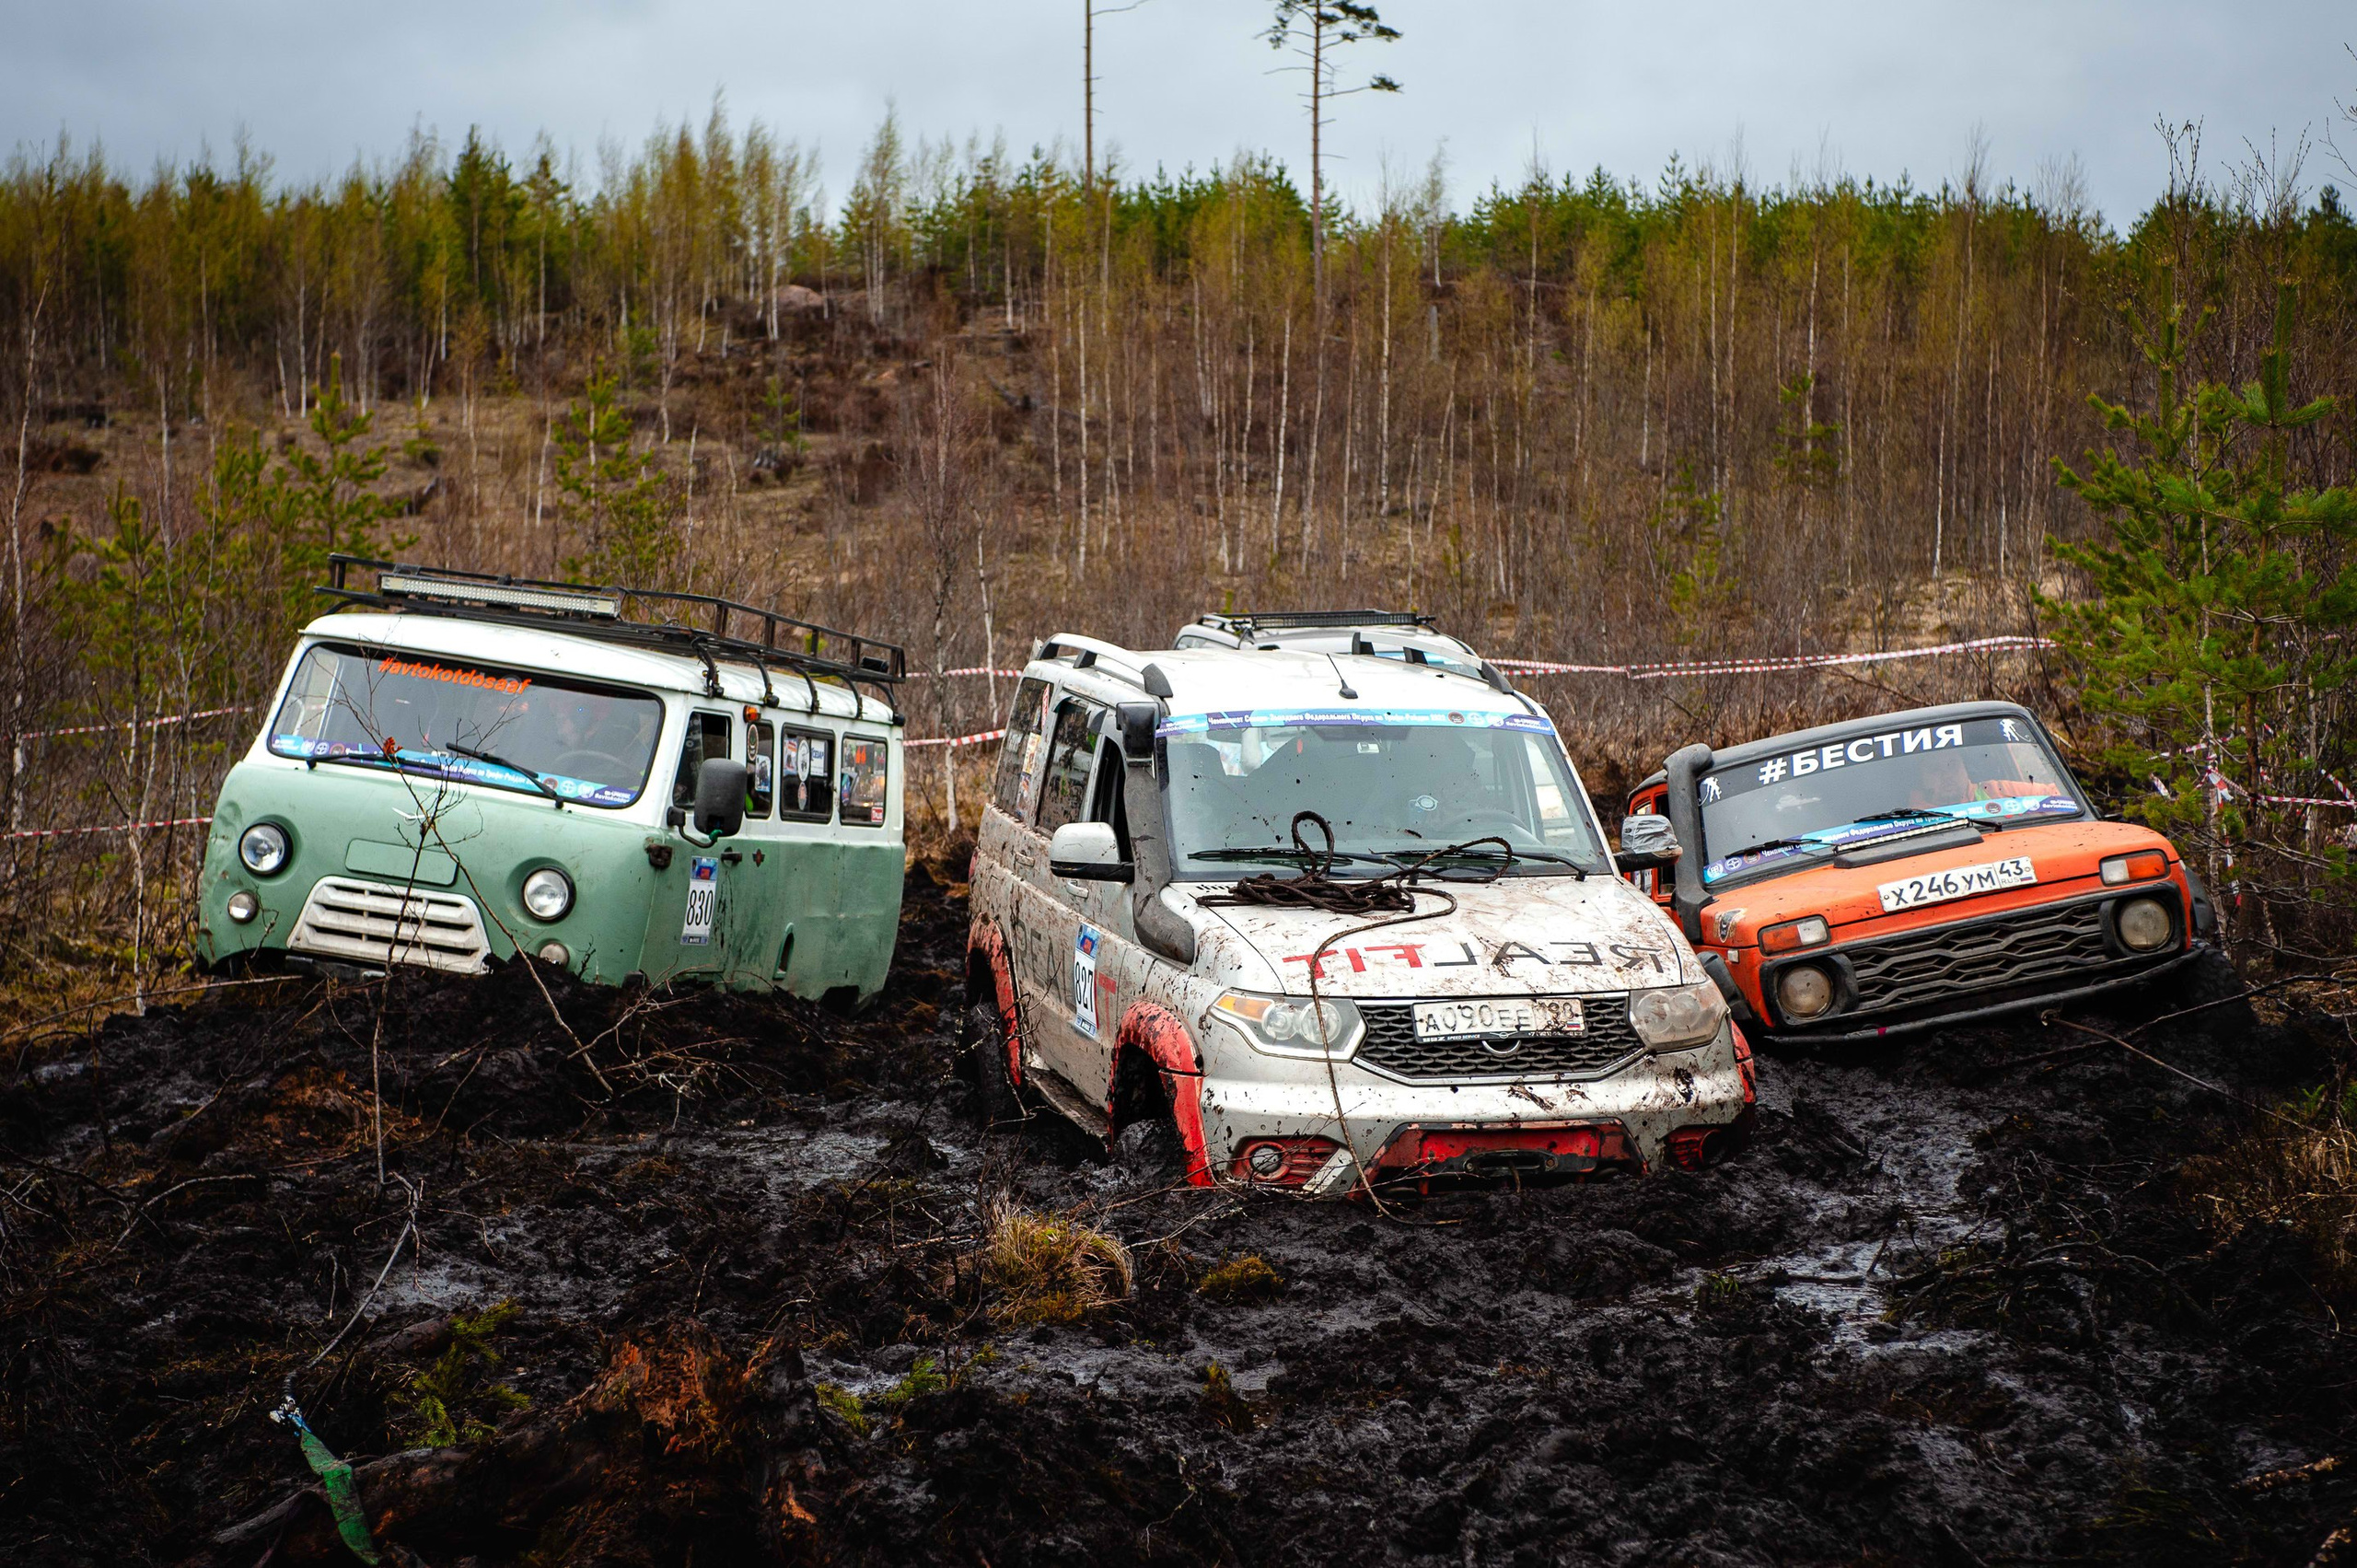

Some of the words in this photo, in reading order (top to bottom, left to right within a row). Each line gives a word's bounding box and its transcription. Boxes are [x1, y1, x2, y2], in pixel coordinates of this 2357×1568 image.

[378, 657, 531, 694] #avtokotdosaaf
[1759, 724, 1964, 785] #БЕСТИЯ
[1892, 871, 1996, 906] Х246УМ
[1999, 860, 2024, 877] 43
[2001, 877, 2019, 885] RUS
[686, 889, 714, 926] 830
[1074, 961, 1094, 1013] 827
